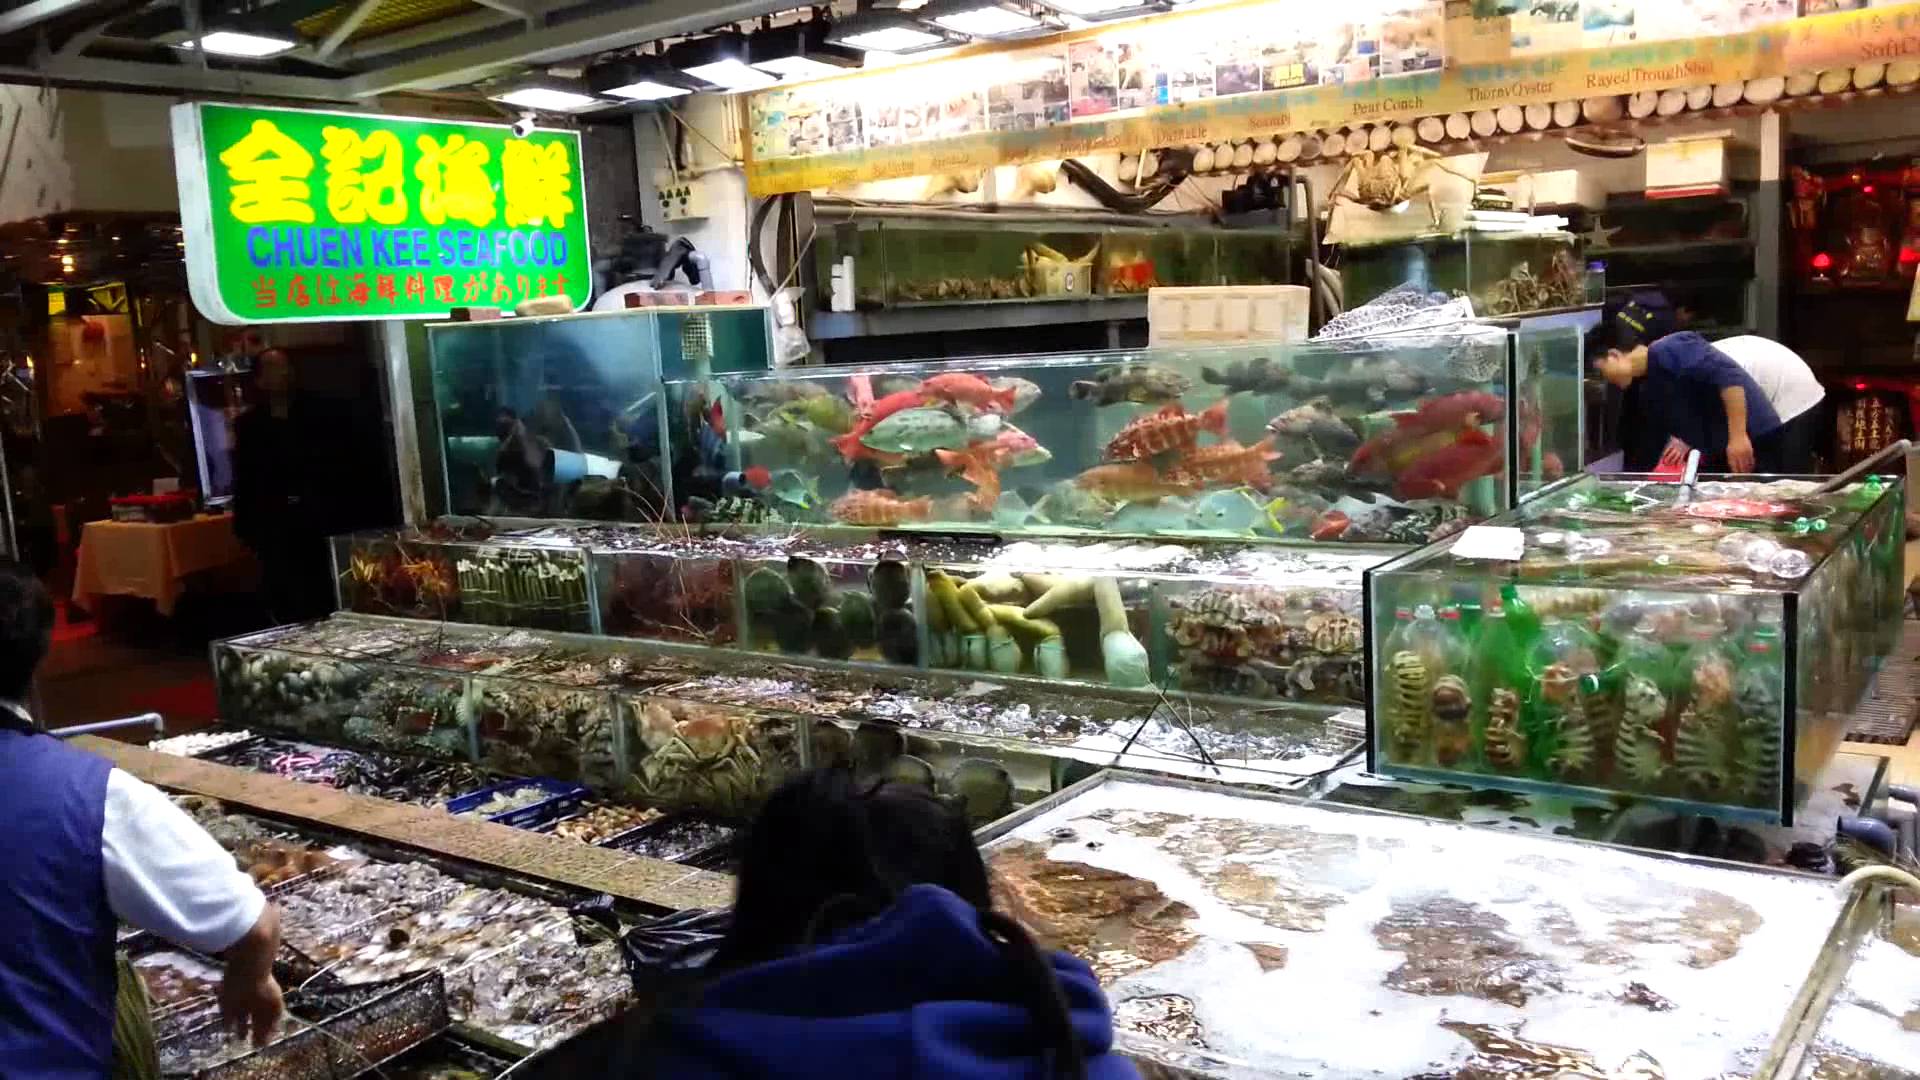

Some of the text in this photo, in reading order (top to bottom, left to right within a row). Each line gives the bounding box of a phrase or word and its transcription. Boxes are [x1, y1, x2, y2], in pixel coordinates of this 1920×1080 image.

[1585, 69, 1630, 89] Rayed
[219, 119, 574, 228] 全記海鮮
[246, 226, 568, 268] CHUEN KEE SEAFOOD
